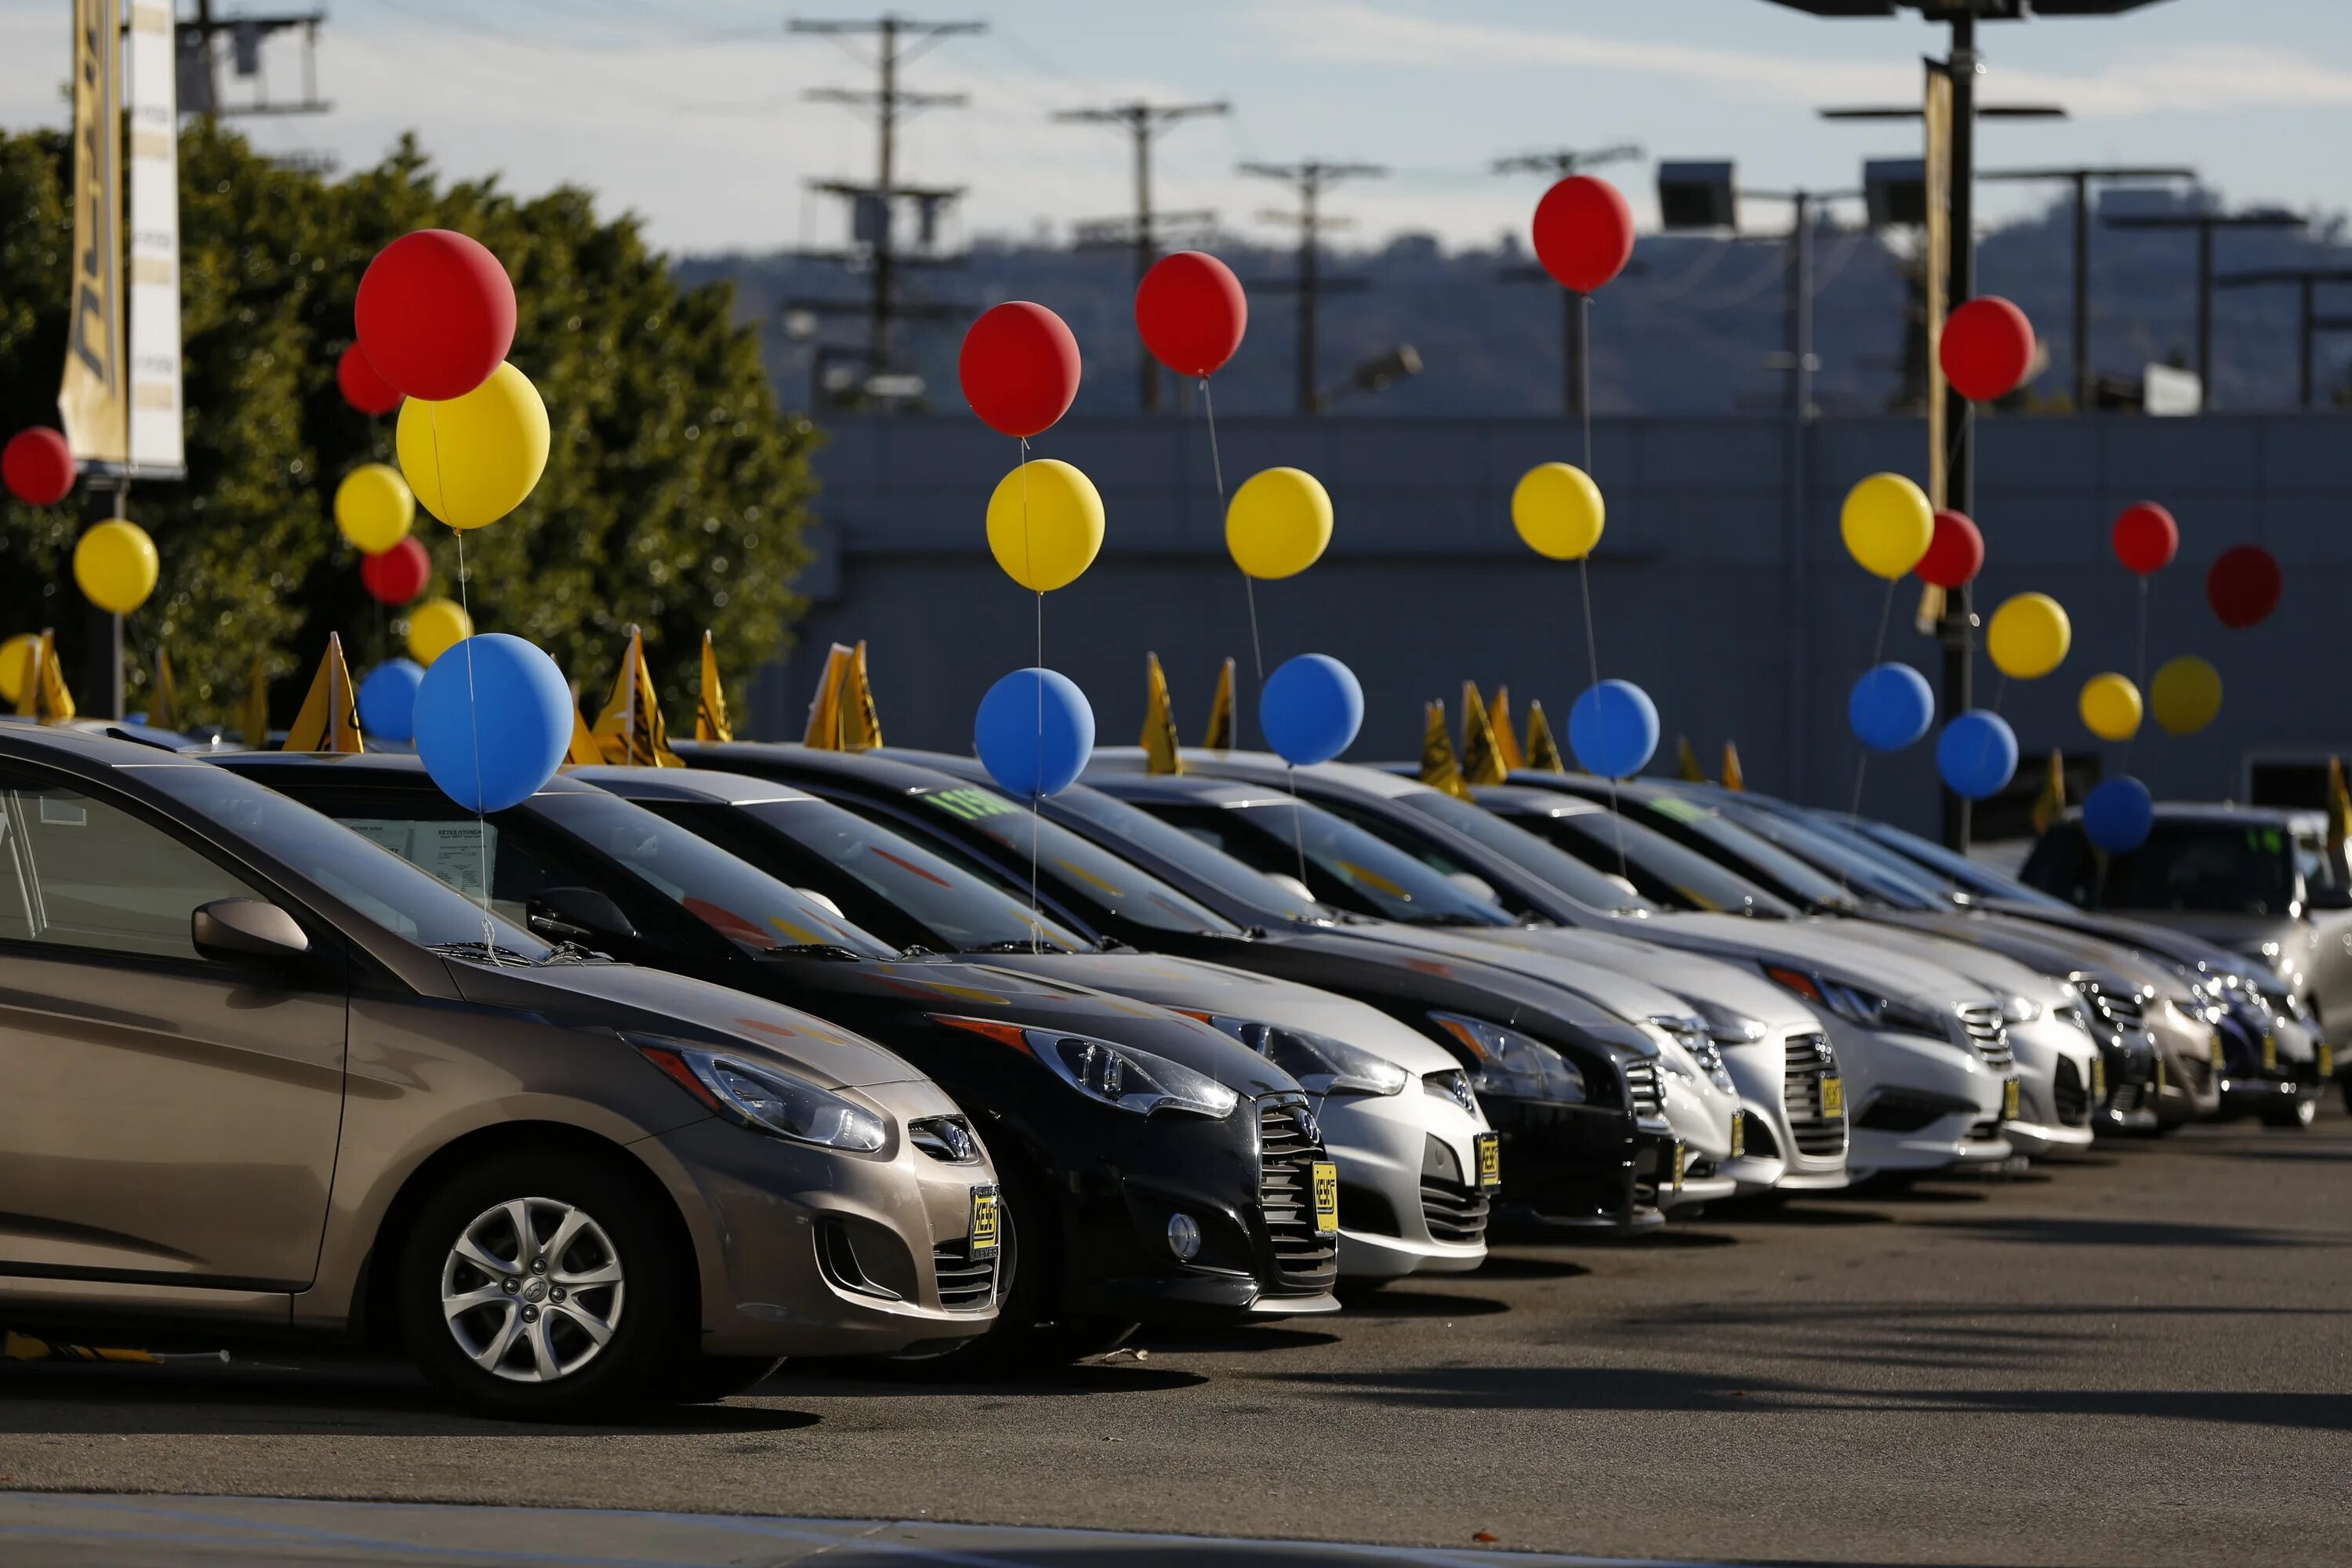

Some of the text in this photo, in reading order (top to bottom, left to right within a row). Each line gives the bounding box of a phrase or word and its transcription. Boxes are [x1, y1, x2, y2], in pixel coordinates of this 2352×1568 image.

[1316, 1178, 1335, 1214] KEYES
[972, 1201, 998, 1240] KEYES
[975, 1247, 998, 1258] KEYES
